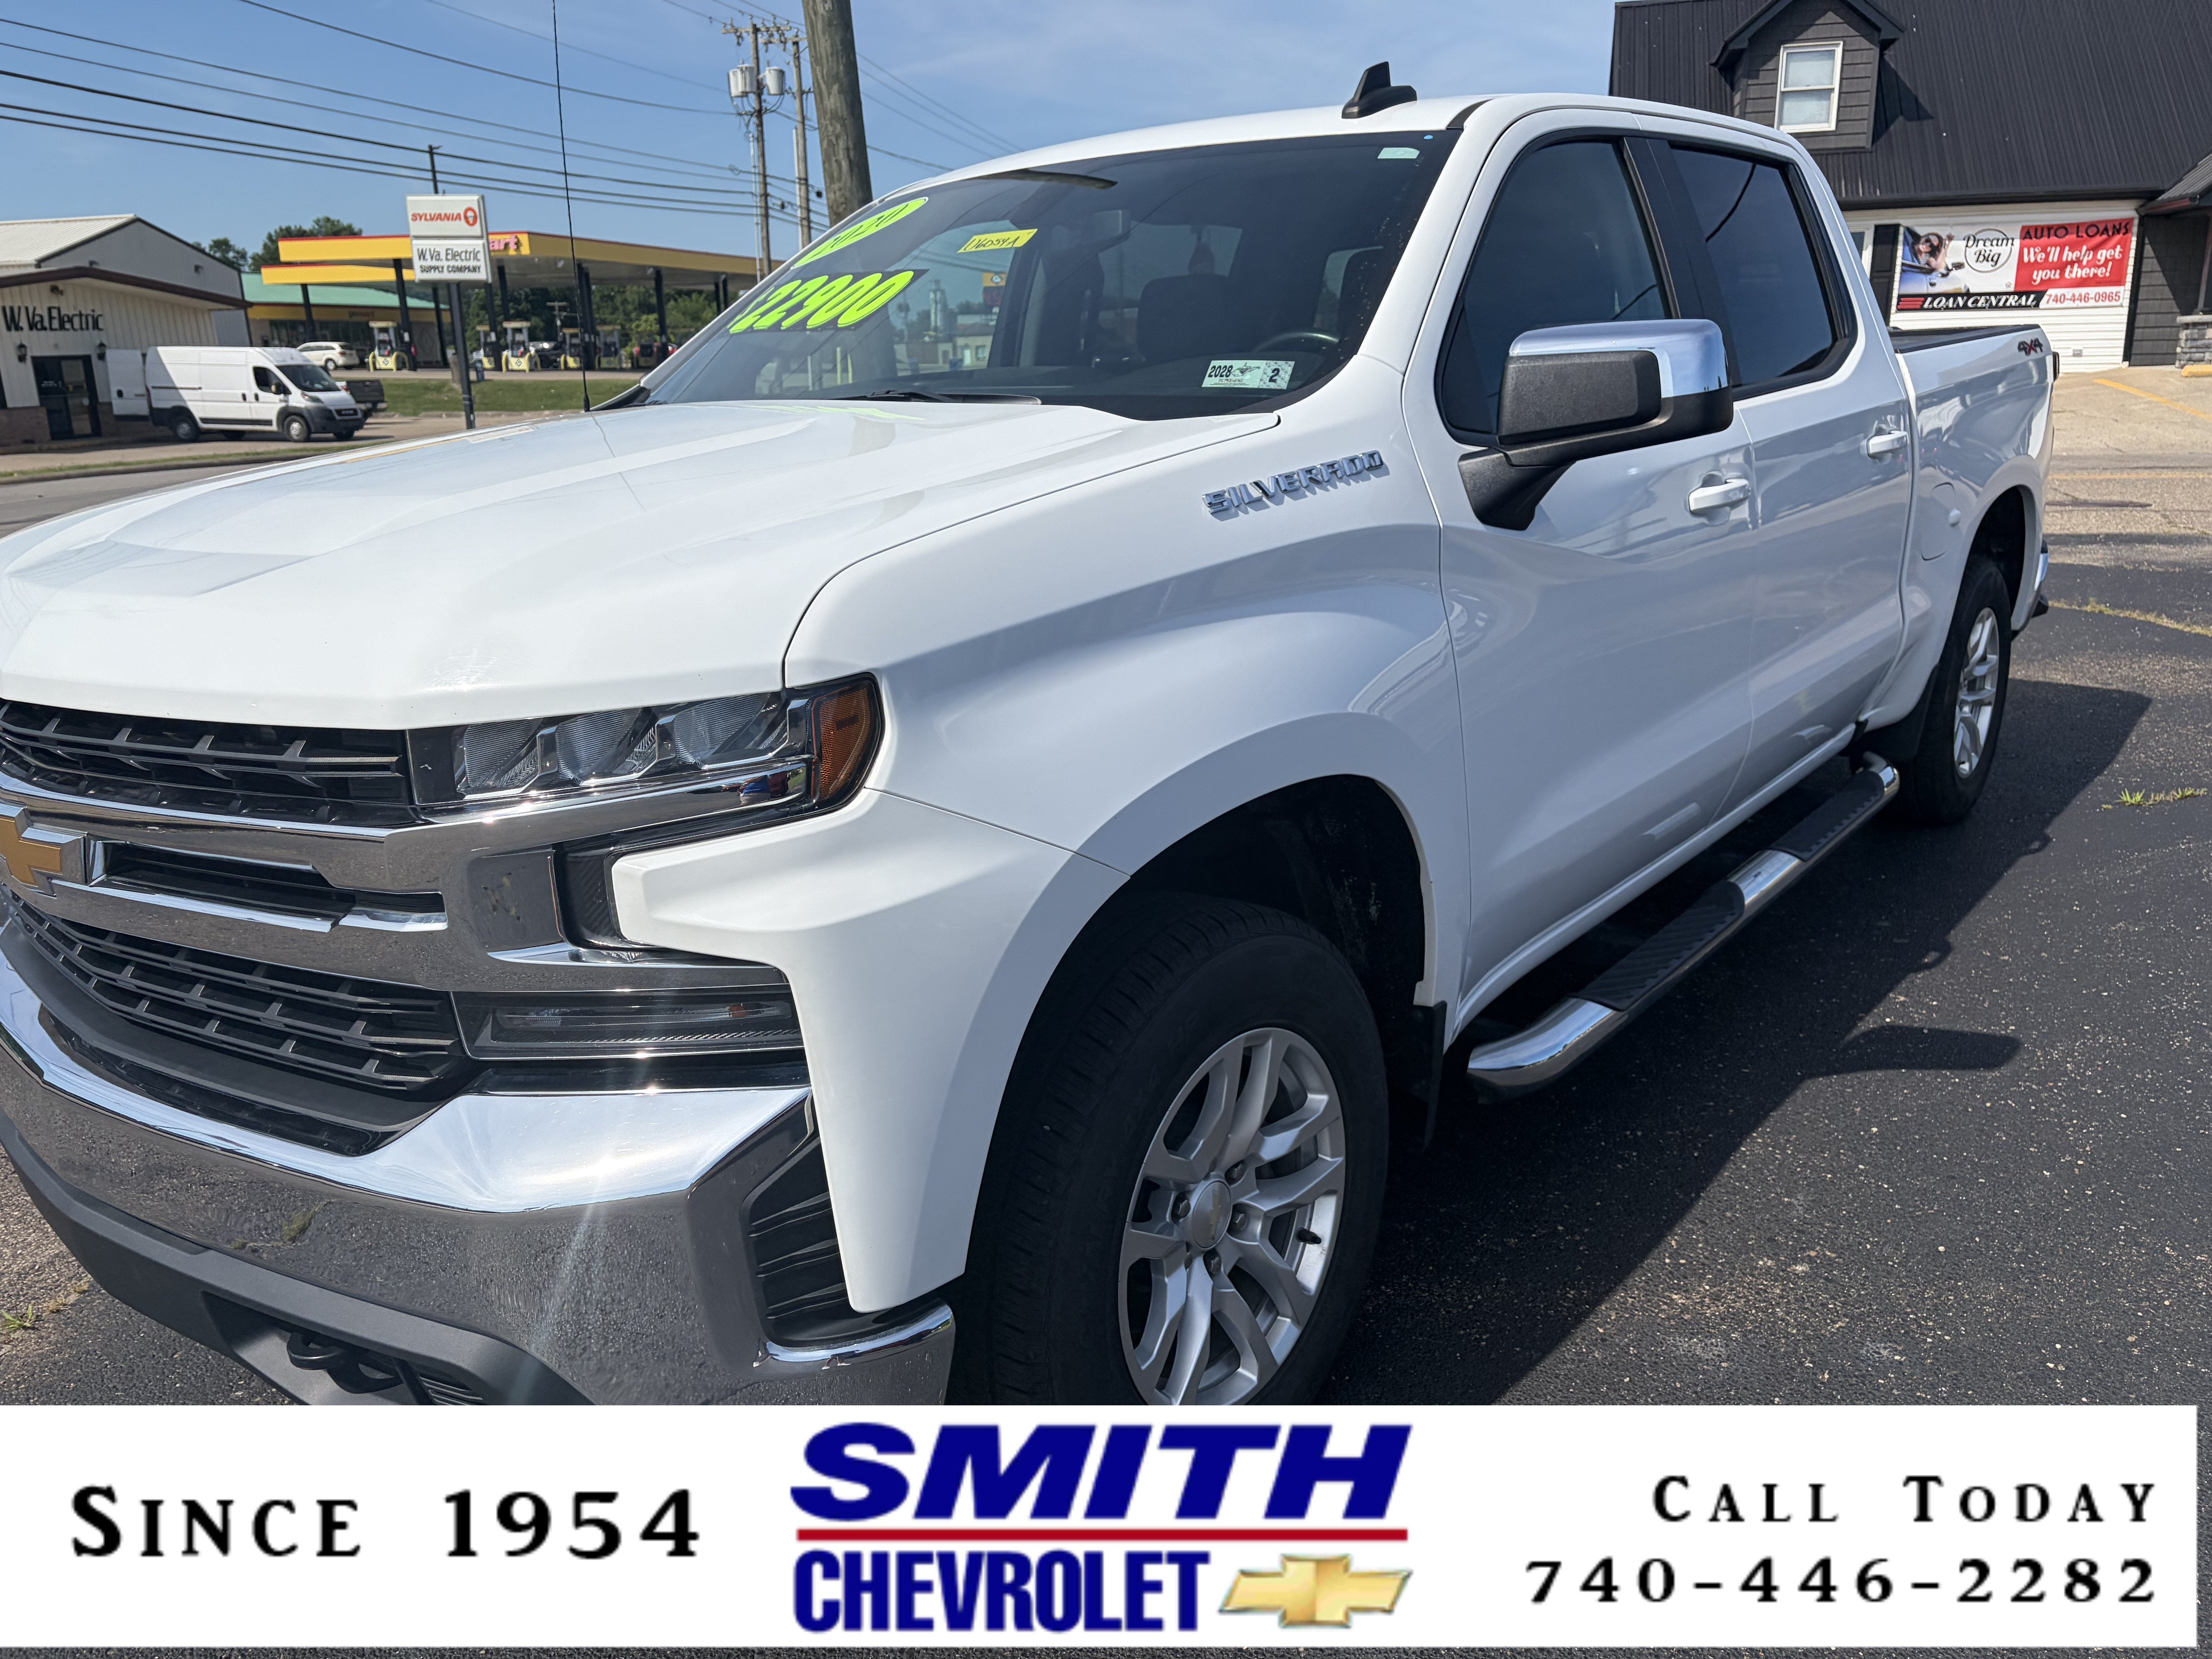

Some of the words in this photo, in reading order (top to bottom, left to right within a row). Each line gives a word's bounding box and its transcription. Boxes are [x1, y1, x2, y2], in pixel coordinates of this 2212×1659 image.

[411, 212, 462, 222] SYLVANIA
[2023, 225, 2069, 240] AUTO
[2076, 222, 2129, 238] LOANS
[1963, 234, 2014, 249] Dream
[417, 247, 428, 262] W.
[428, 247, 443, 262] Va.
[445, 247, 481, 262] Electric
[1975, 248, 2001, 267] Big
[2023, 246, 2060, 263] We'll
[2063, 245, 2093, 266] help
[2096, 244, 2123, 265] get
[419, 264, 444, 273] SUPPLY
[447, 264, 481, 273] COMPANY
[2032, 269, 2061, 285] you
[2064, 261, 2112, 279] there!
[1923, 296, 1967, 309] LOAN
[1967, 294, 2037, 308] CENTRAL
[2046, 291, 2121, 304] 740-446-0965
[1, 306, 23, 331] W.
[25, 306, 48, 331] Va.
[47, 306, 104, 331] Electric
[1207, 365, 1233, 378] 2028
[1269, 368, 1280, 383] 2
[1201, 450, 1384, 514] SILVERADO
